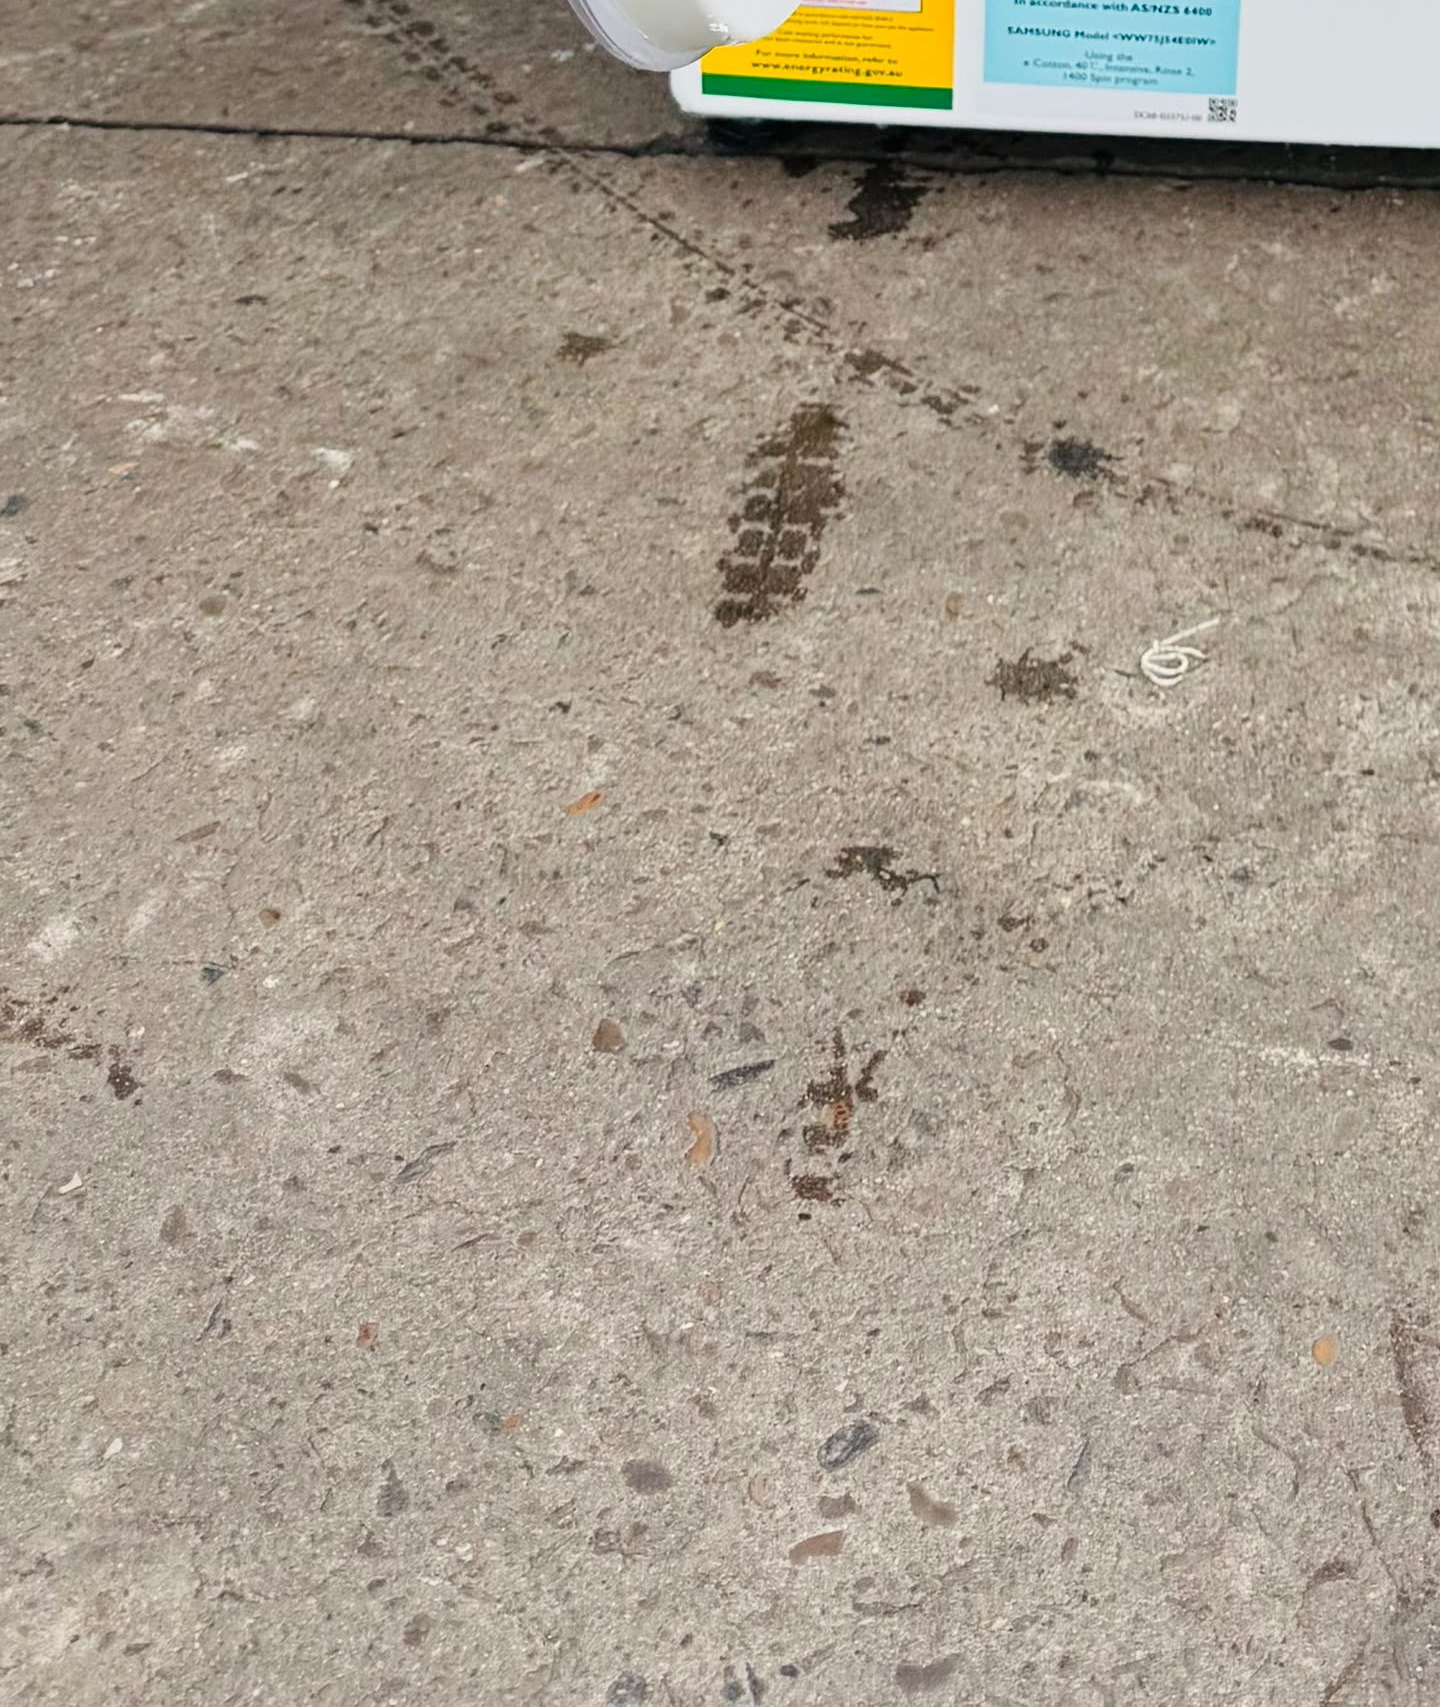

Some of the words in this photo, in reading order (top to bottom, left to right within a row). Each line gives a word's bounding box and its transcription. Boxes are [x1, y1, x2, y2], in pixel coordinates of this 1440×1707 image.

[1102, 0, 1128, 12] with
[1007, 25, 1072, 38] SAMSUNG
[1074, 28, 1110, 40] Model
